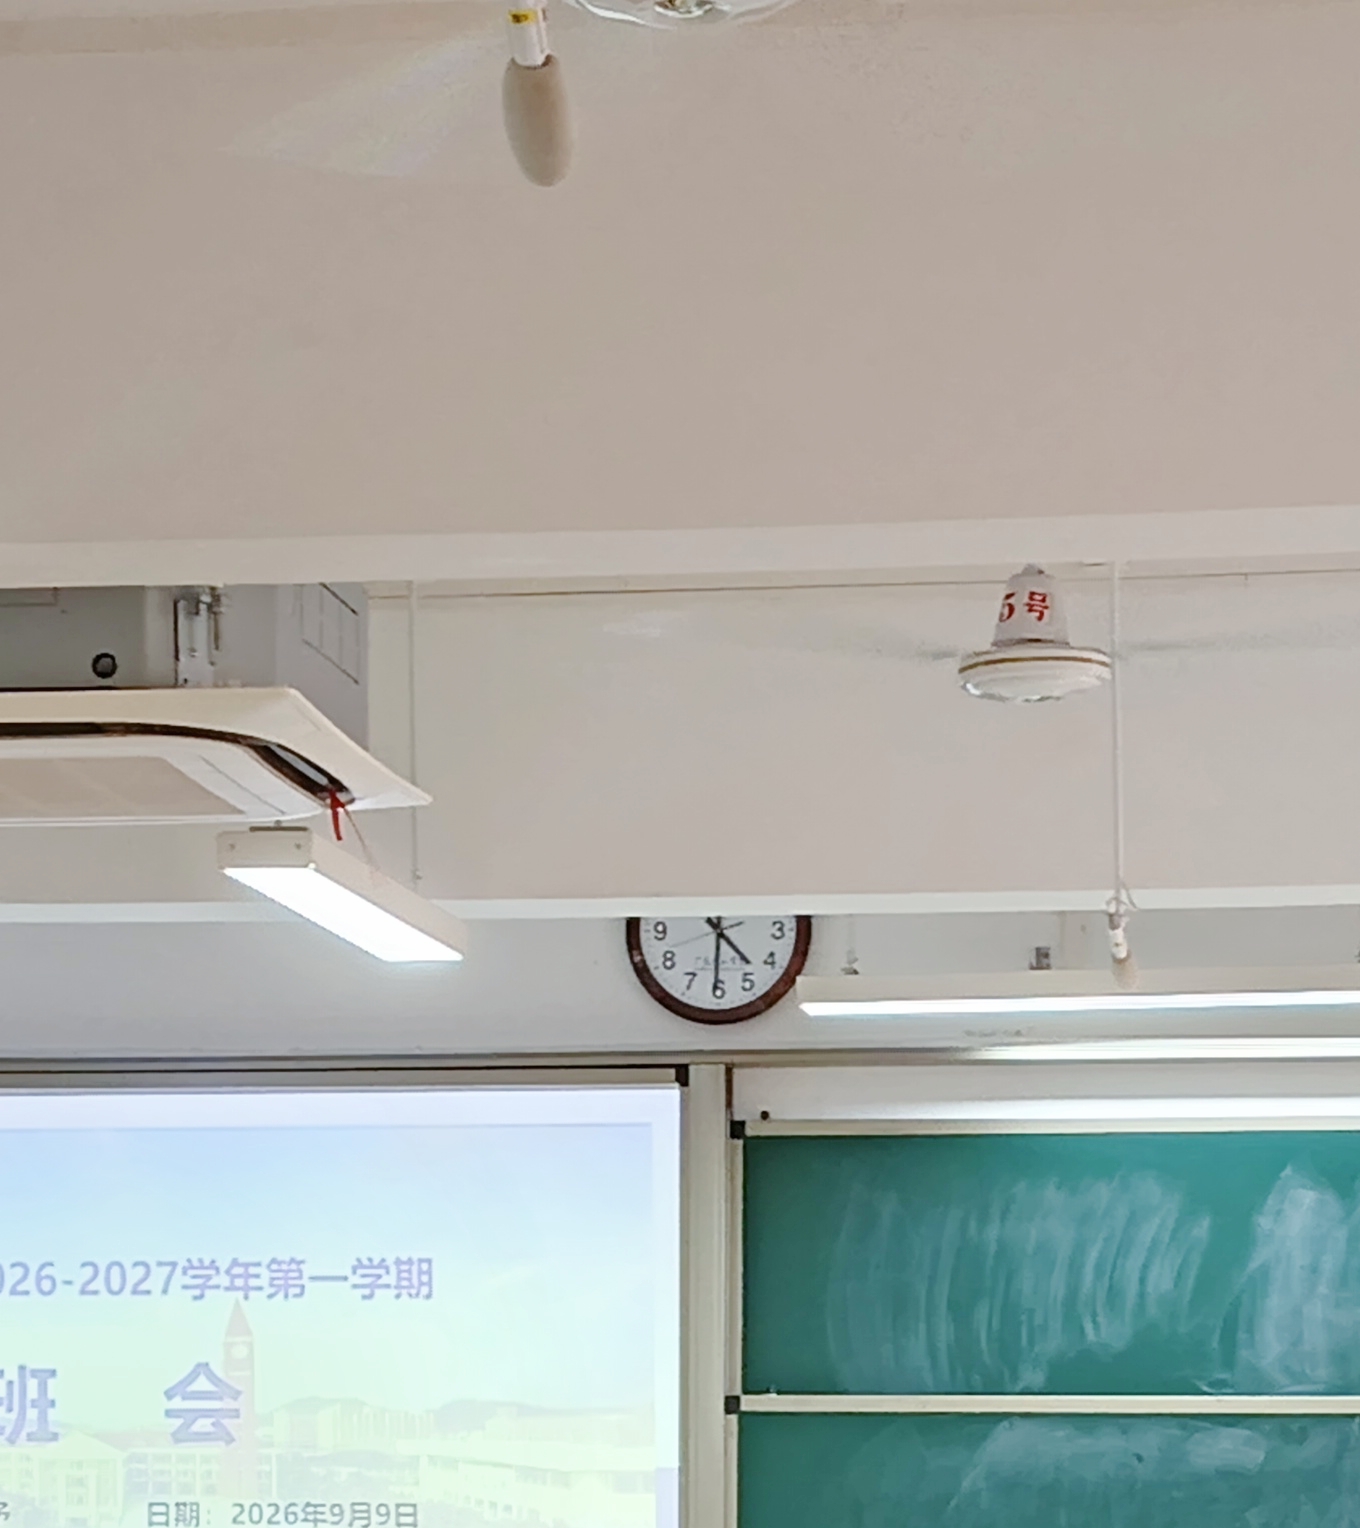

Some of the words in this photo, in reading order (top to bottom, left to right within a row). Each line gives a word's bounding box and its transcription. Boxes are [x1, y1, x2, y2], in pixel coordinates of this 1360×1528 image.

[653, 921, 667, 941] 9
[770, 920, 785, 940] 3
[662, 950, 676, 970] 8
[762, 951, 777, 968] 4
[683, 971, 698, 991] 7
[712, 979, 726, 999] 6
[740, 972, 755, 992] 5
[162, 1361, 244, 1448] 会
